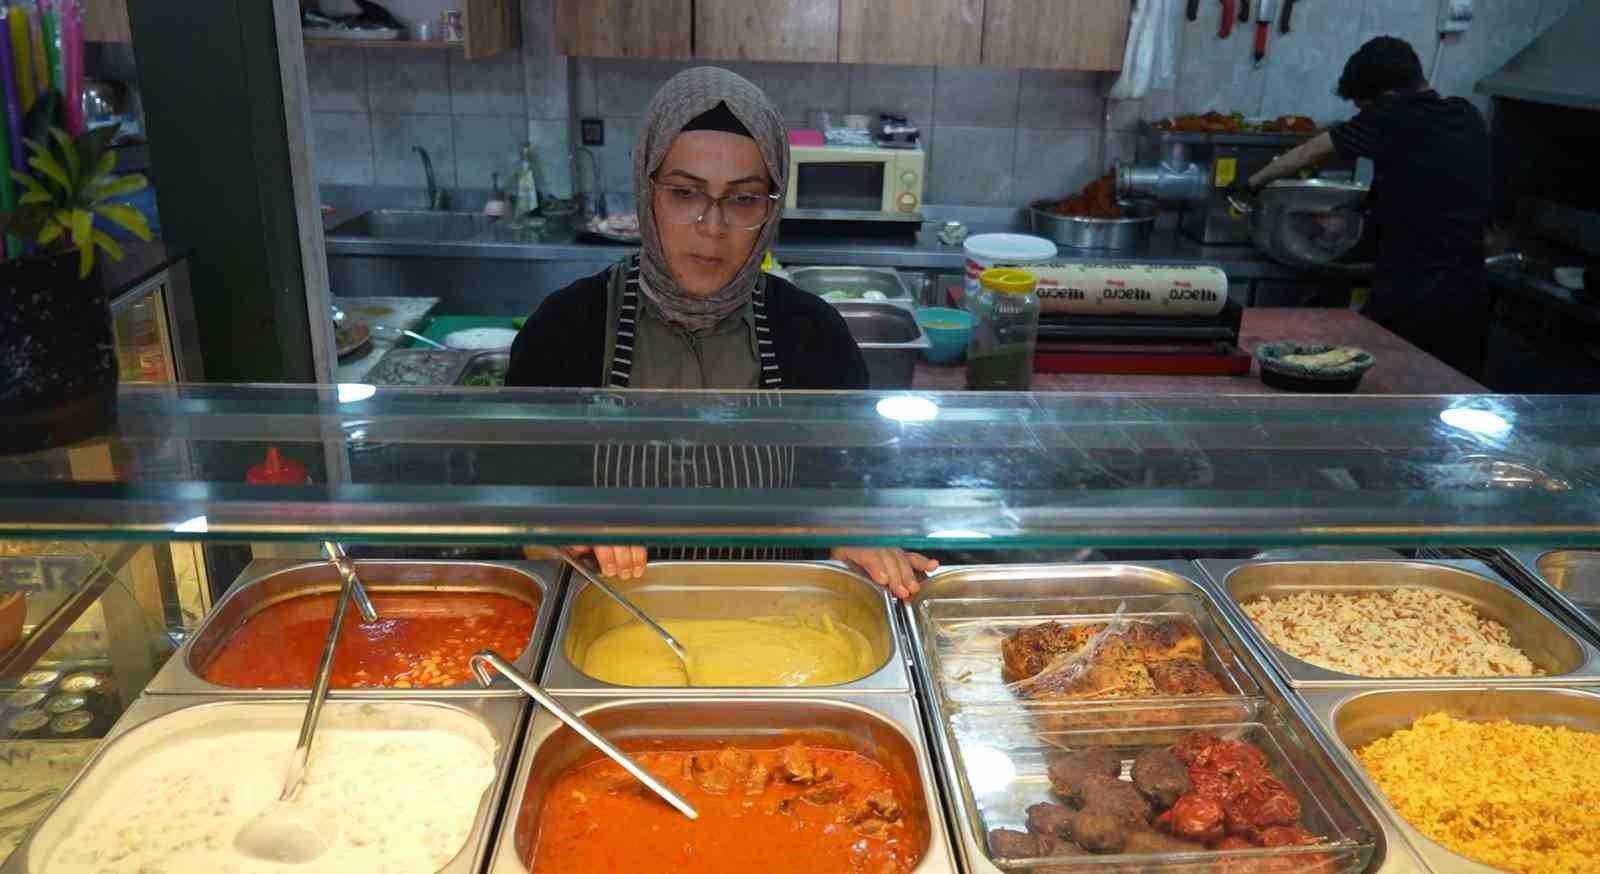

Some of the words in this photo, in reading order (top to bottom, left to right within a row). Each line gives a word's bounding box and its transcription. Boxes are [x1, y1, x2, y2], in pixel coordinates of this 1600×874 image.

[1104, 287, 1151, 300] macro
[1169, 288, 1217, 301] macro
[0, 559, 80, 592] ER
